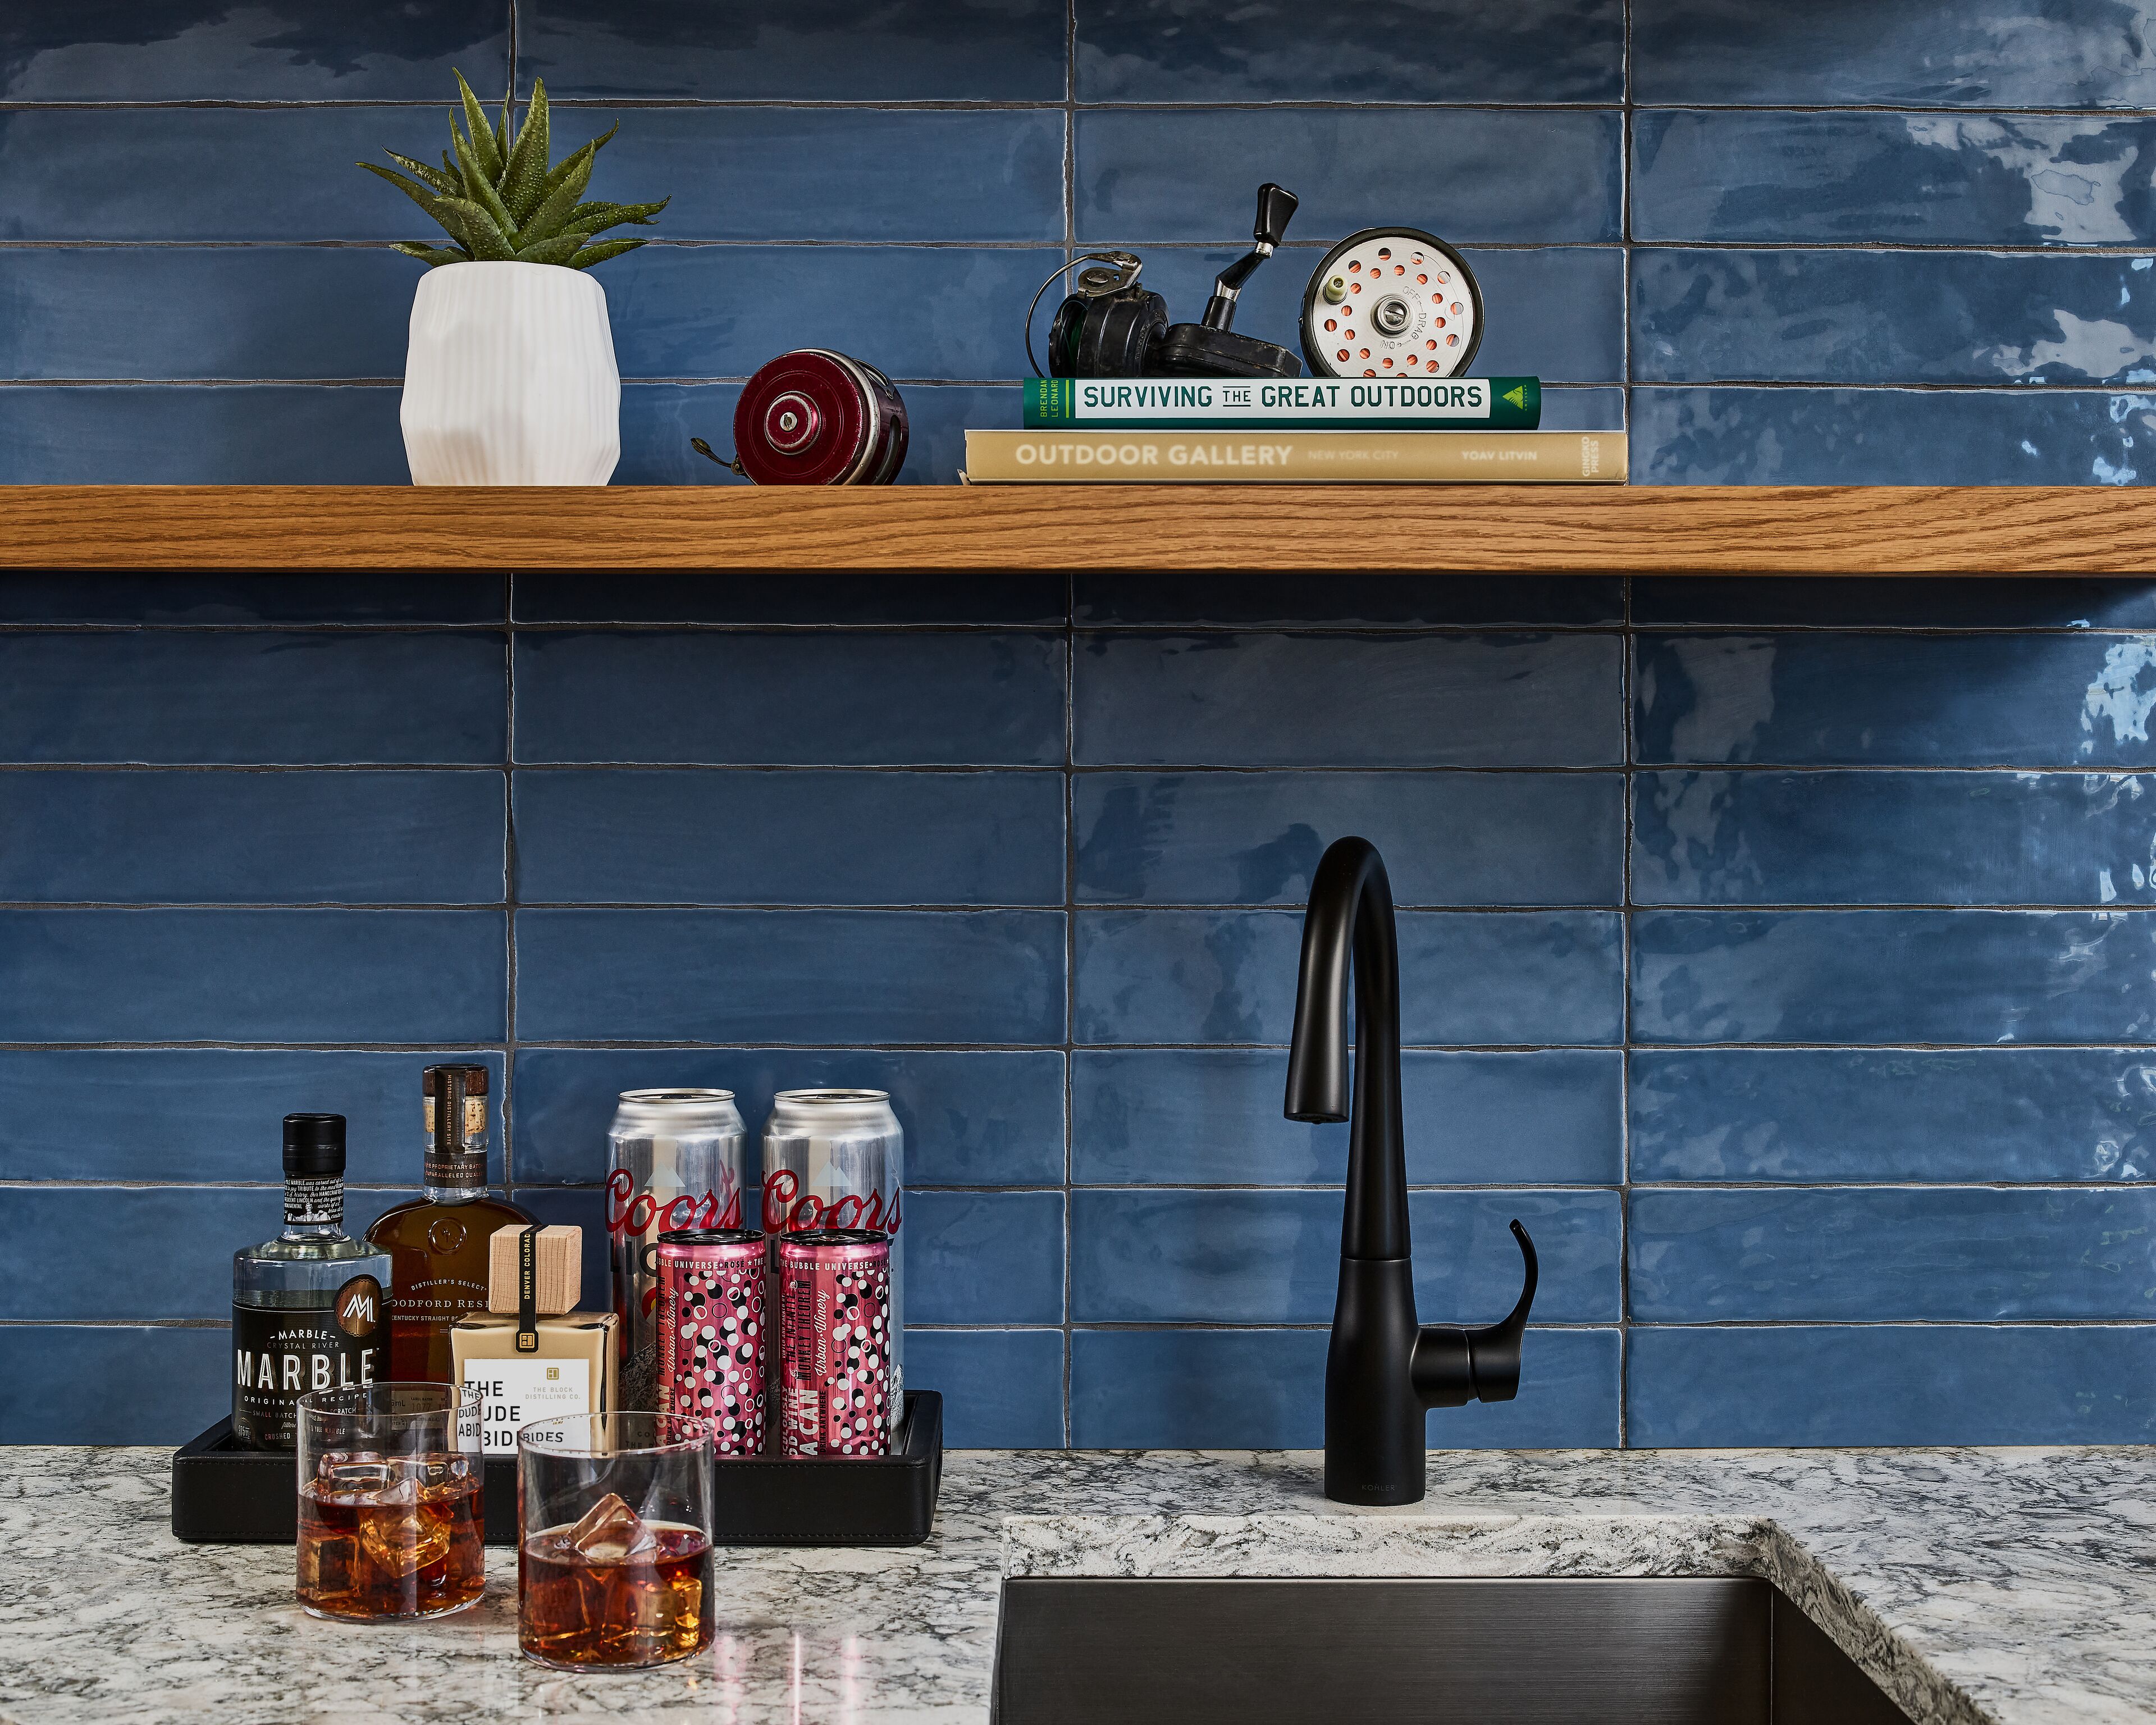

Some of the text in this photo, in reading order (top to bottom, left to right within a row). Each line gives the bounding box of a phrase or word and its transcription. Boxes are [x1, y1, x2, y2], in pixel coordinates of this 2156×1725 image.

[1402, 286, 1421, 301] OFF
[1411, 312, 1427, 340] DRAG
[1381, 340, 1395, 350] ON
[1084, 386, 1482, 408] SURVIVING THE GREAT OUTDOORS
[1016, 444, 1293, 466] OUTDOOR GALLERY
[1308, 451, 1399, 460] NEW YORK CITY
[1462, 451, 1537, 460] YOAV LITVIN
[1581, 436, 1590, 477] GINGKO
[1590, 440, 1599, 473] PRESS
[604, 1168, 744, 1236] Coors
[761, 1169, 903, 1235] Coors
[675, 1261, 718, 1269] UNIVERSE
[724, 1258, 744, 1268] ROSÉ
[754, 1257, 763, 1266] THE
[790, 1261, 820, 1271] BUBBLE
[825, 1261, 869, 1271] UNIVERSE
[411, 1279, 455, 1291] DISTILLER'S
[392, 1299, 489, 1308] OODFORD RES
[814, 1289, 830, 1333] Winery
[278, 1329, 328, 1340] MARBLE
[787, 1292, 797, 1363] THE INFINITE
[797, 1280, 812, 1381] MONKEY THEOREM
[237, 1348, 374, 1390] MARBLE
[322, 1393, 367, 1403] RECIPE
[788, 1388, 798, 1430] WINE
[484, 1405, 520, 1421] UDE
[799, 1389, 819, 1435] CAN
[281, 1421, 296, 1430] filtere
